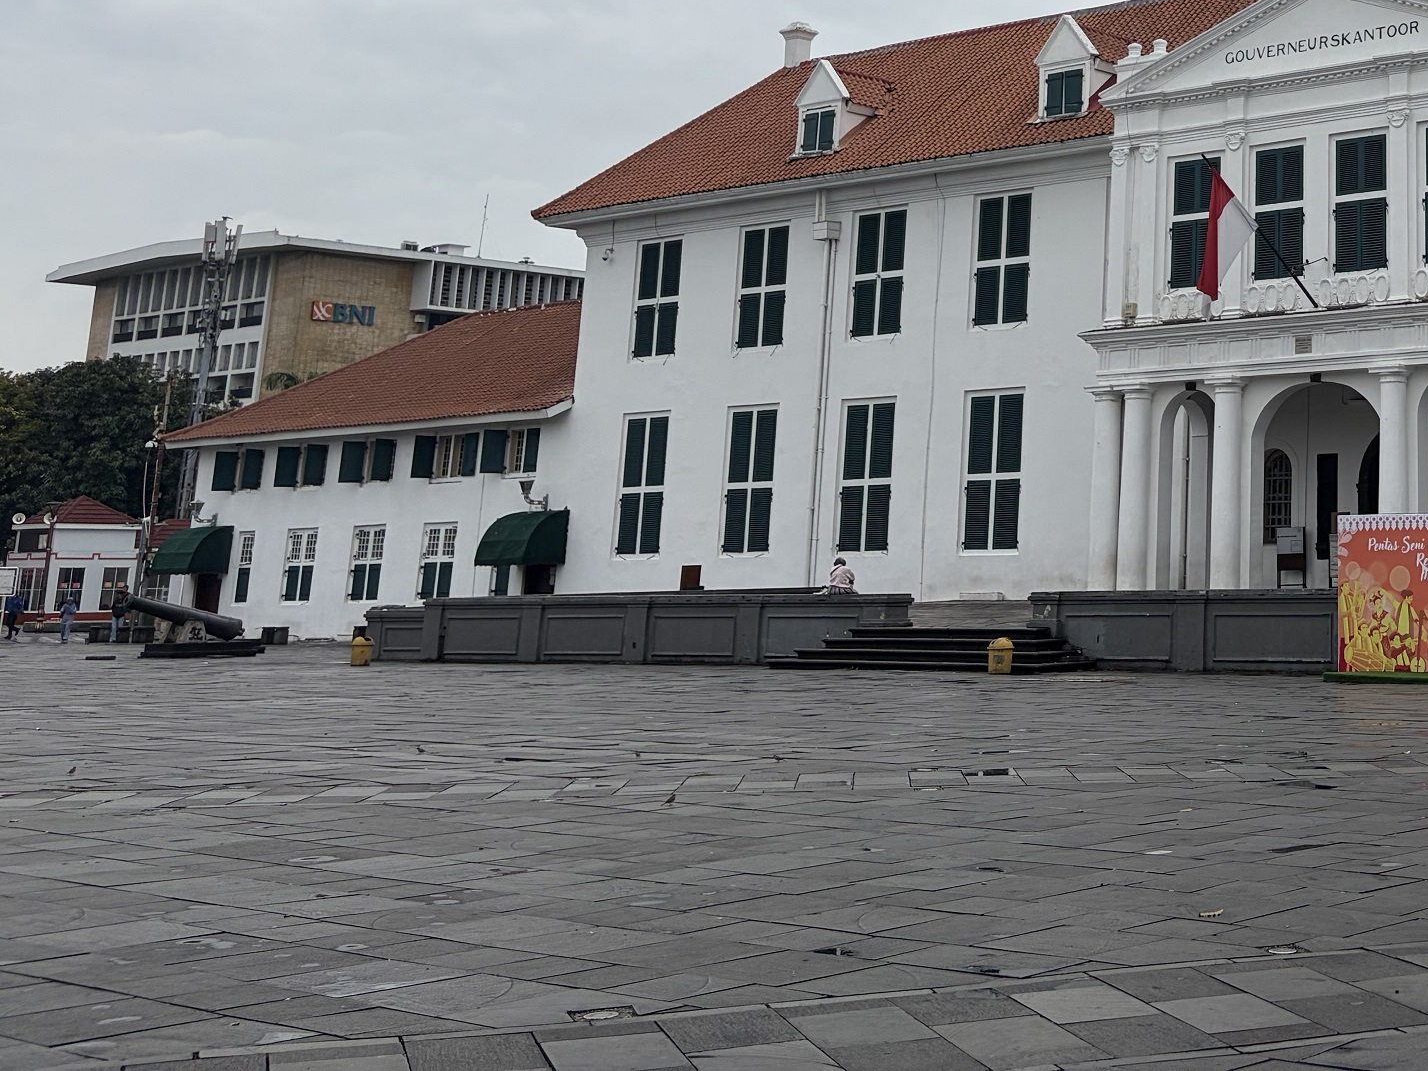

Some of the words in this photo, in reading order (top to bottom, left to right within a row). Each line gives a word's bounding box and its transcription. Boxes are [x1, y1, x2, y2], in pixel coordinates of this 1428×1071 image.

[1224, 20, 1420, 65] GOUVERNEURSKANTOOR
[333, 302, 376, 326] BNI
[1368, 537, 1400, 551] Pentas
[1401, 535, 1425, 554] Seni
